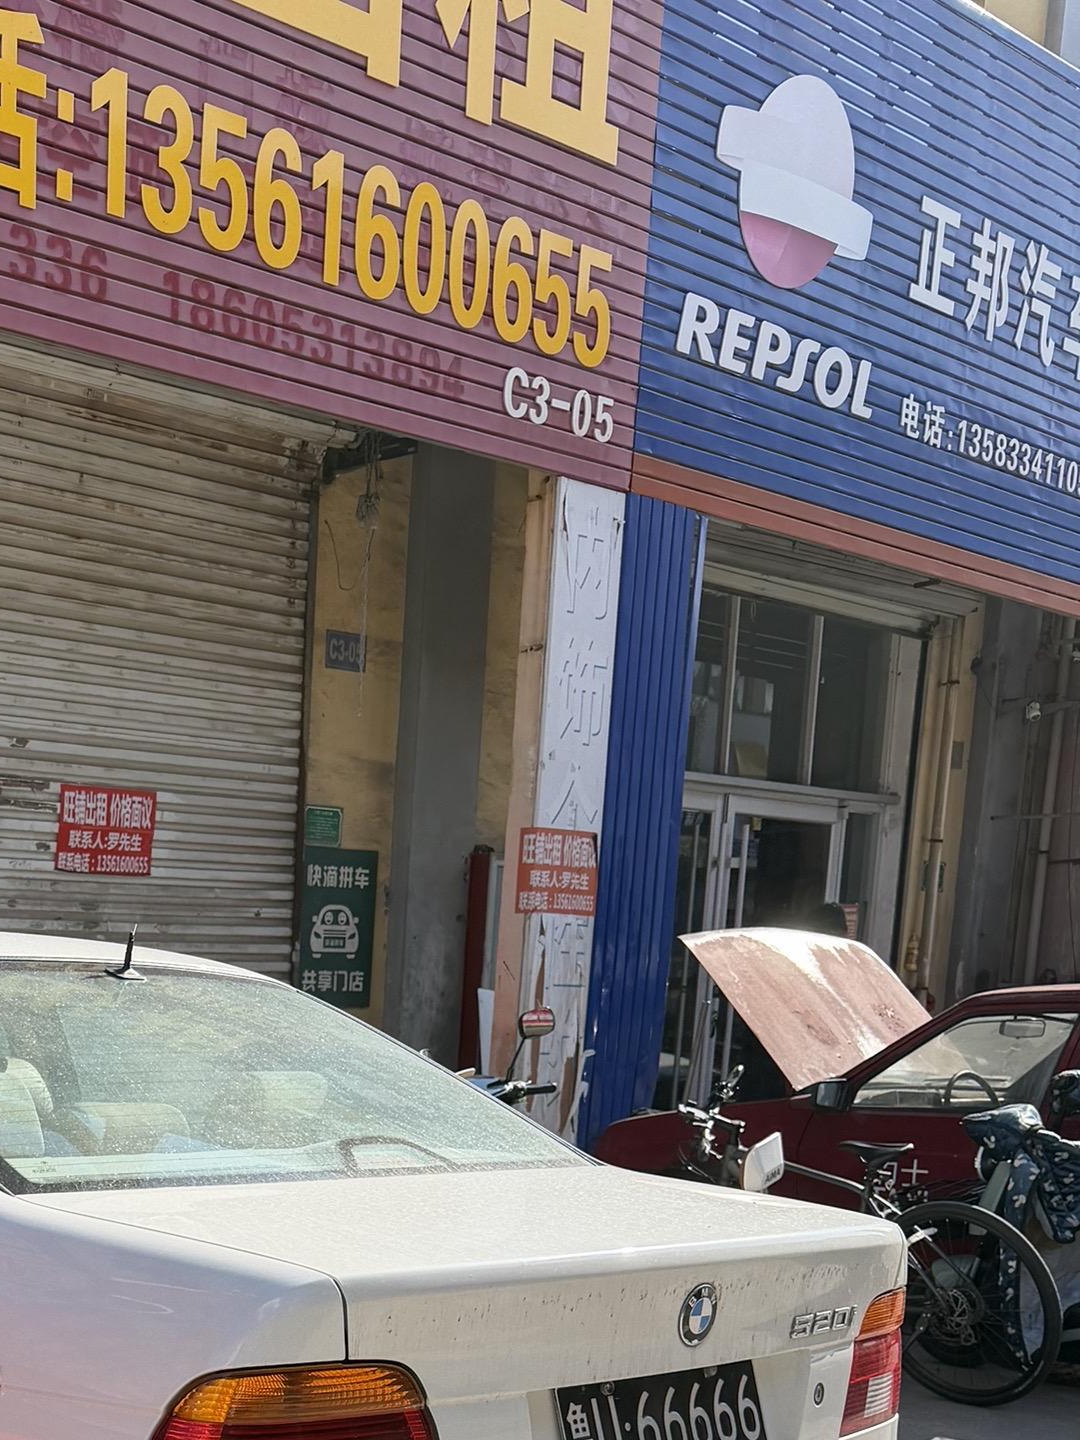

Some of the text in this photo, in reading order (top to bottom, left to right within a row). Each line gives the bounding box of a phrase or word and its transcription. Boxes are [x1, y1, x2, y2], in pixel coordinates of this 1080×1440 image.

[675, 292, 874, 420] REPSOL
[504, 367, 615, 444] C3-05
[899, 393, 1080, 498] 电话:1358334110
[63, 790, 153, 829] 旺铺出租 价格面议
[306, 863, 370, 889] 快滴拼车
[301, 969, 365, 993] 共享门店
